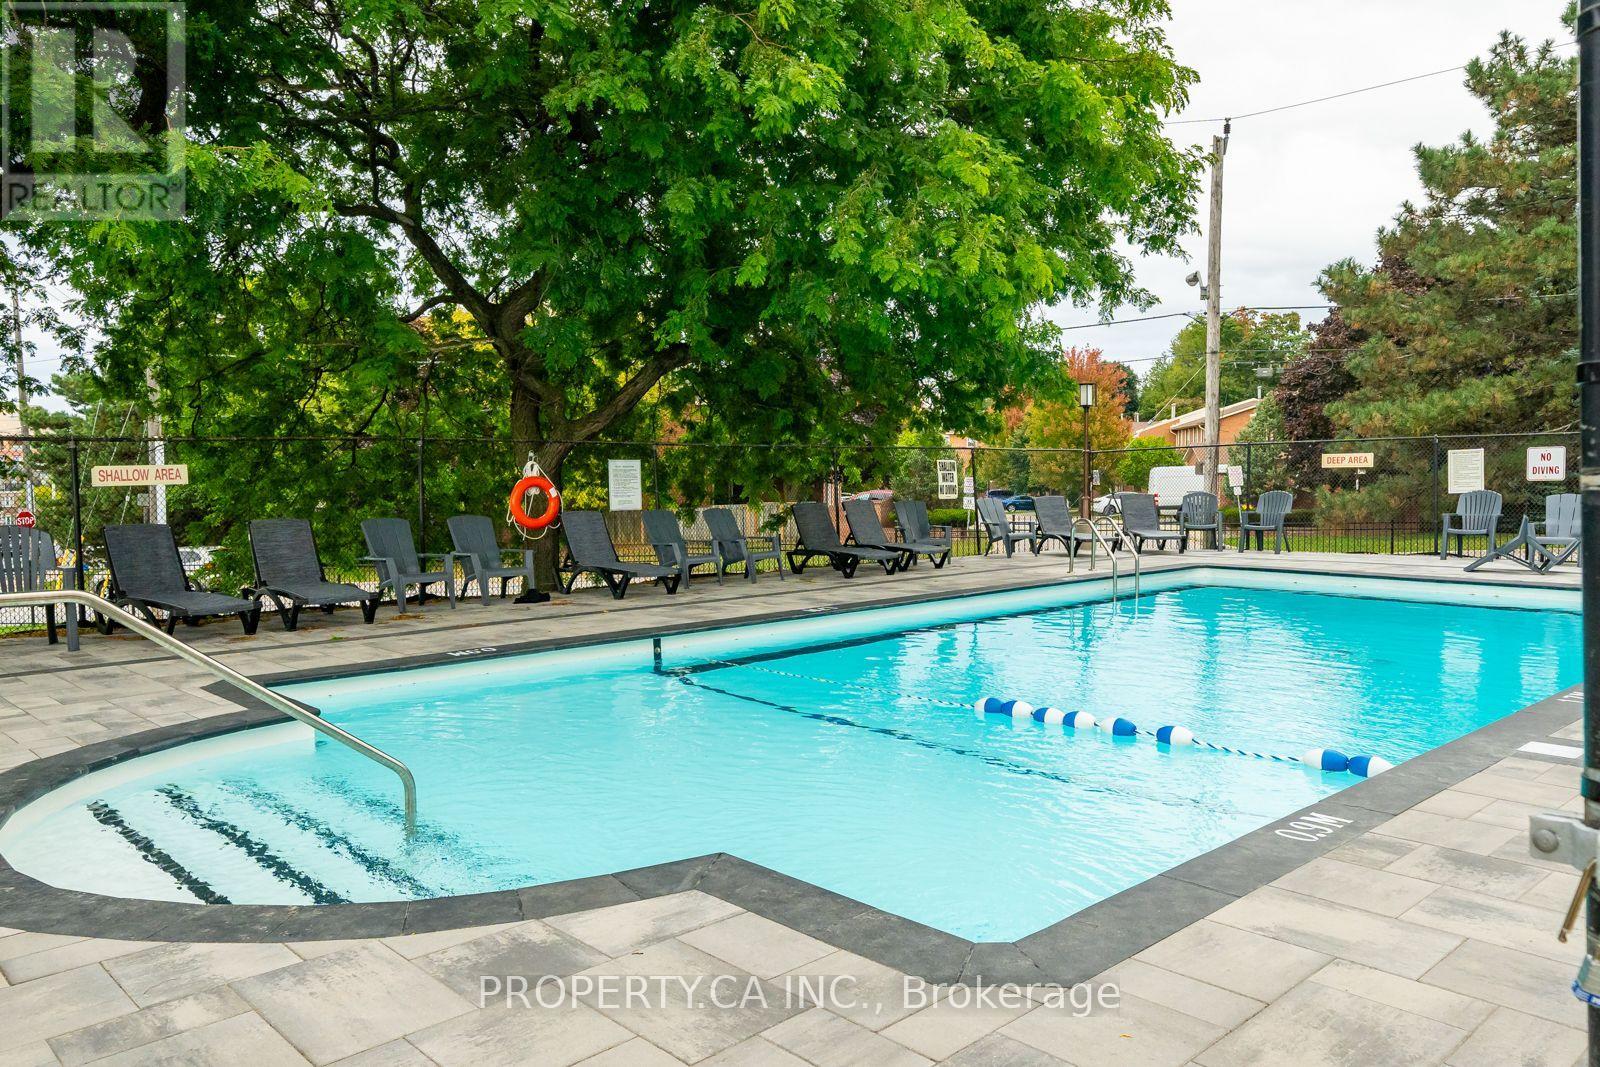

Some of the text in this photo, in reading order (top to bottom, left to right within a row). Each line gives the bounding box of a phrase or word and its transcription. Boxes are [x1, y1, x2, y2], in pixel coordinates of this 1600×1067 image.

[1326, 456, 1369, 465] DEEP AREA
[1540, 452, 1552, 462] NO
[98, 467, 182, 482] SHALLOW AREA
[1532, 465, 1560, 475] DIVING
[941, 472, 955, 483] WATER
[17, 516, 34, 526] STOP
[1274, 811, 1354, 842] 0.9M
